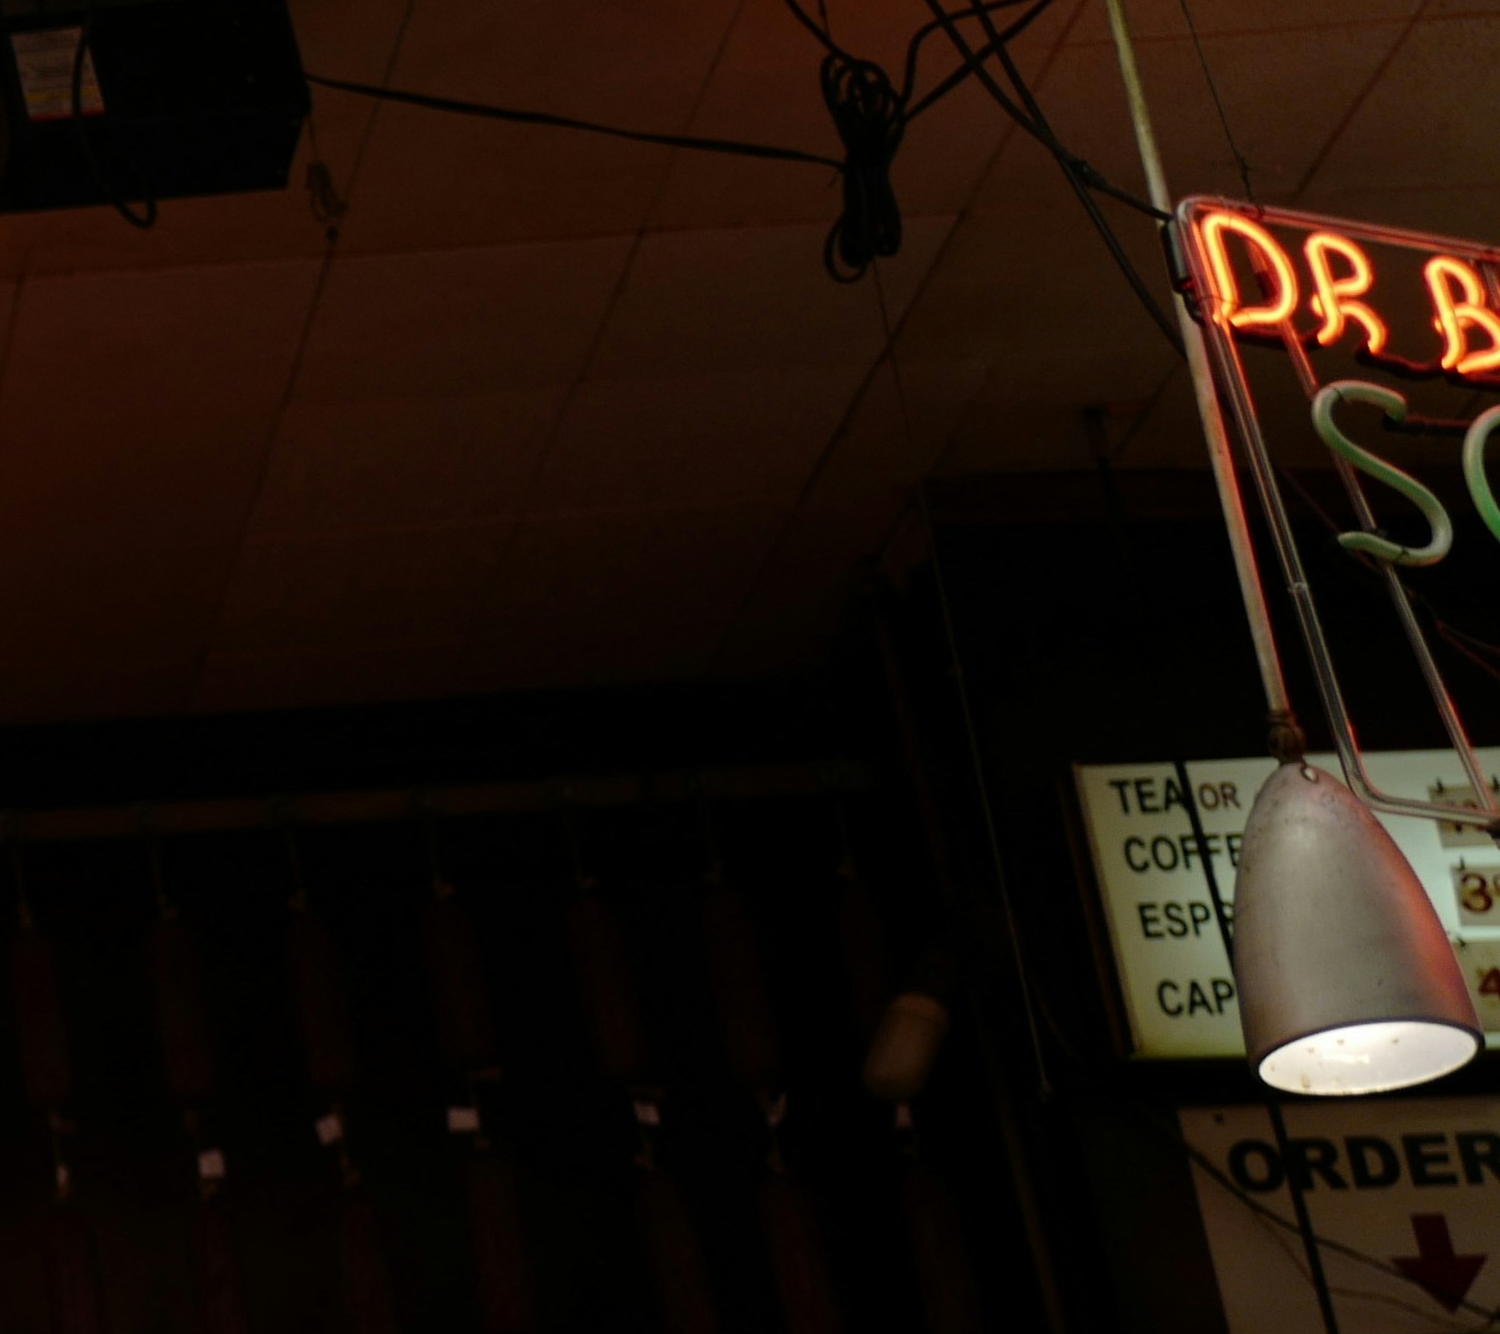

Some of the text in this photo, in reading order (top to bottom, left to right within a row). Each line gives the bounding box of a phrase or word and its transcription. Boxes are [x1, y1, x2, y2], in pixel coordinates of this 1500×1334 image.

[1201, 212, 1388, 356] DR
[1108, 777, 1242, 815] TEA OR
[1157, 978, 1235, 1018] CAP
[1228, 1131, 1500, 1192] ORDER
